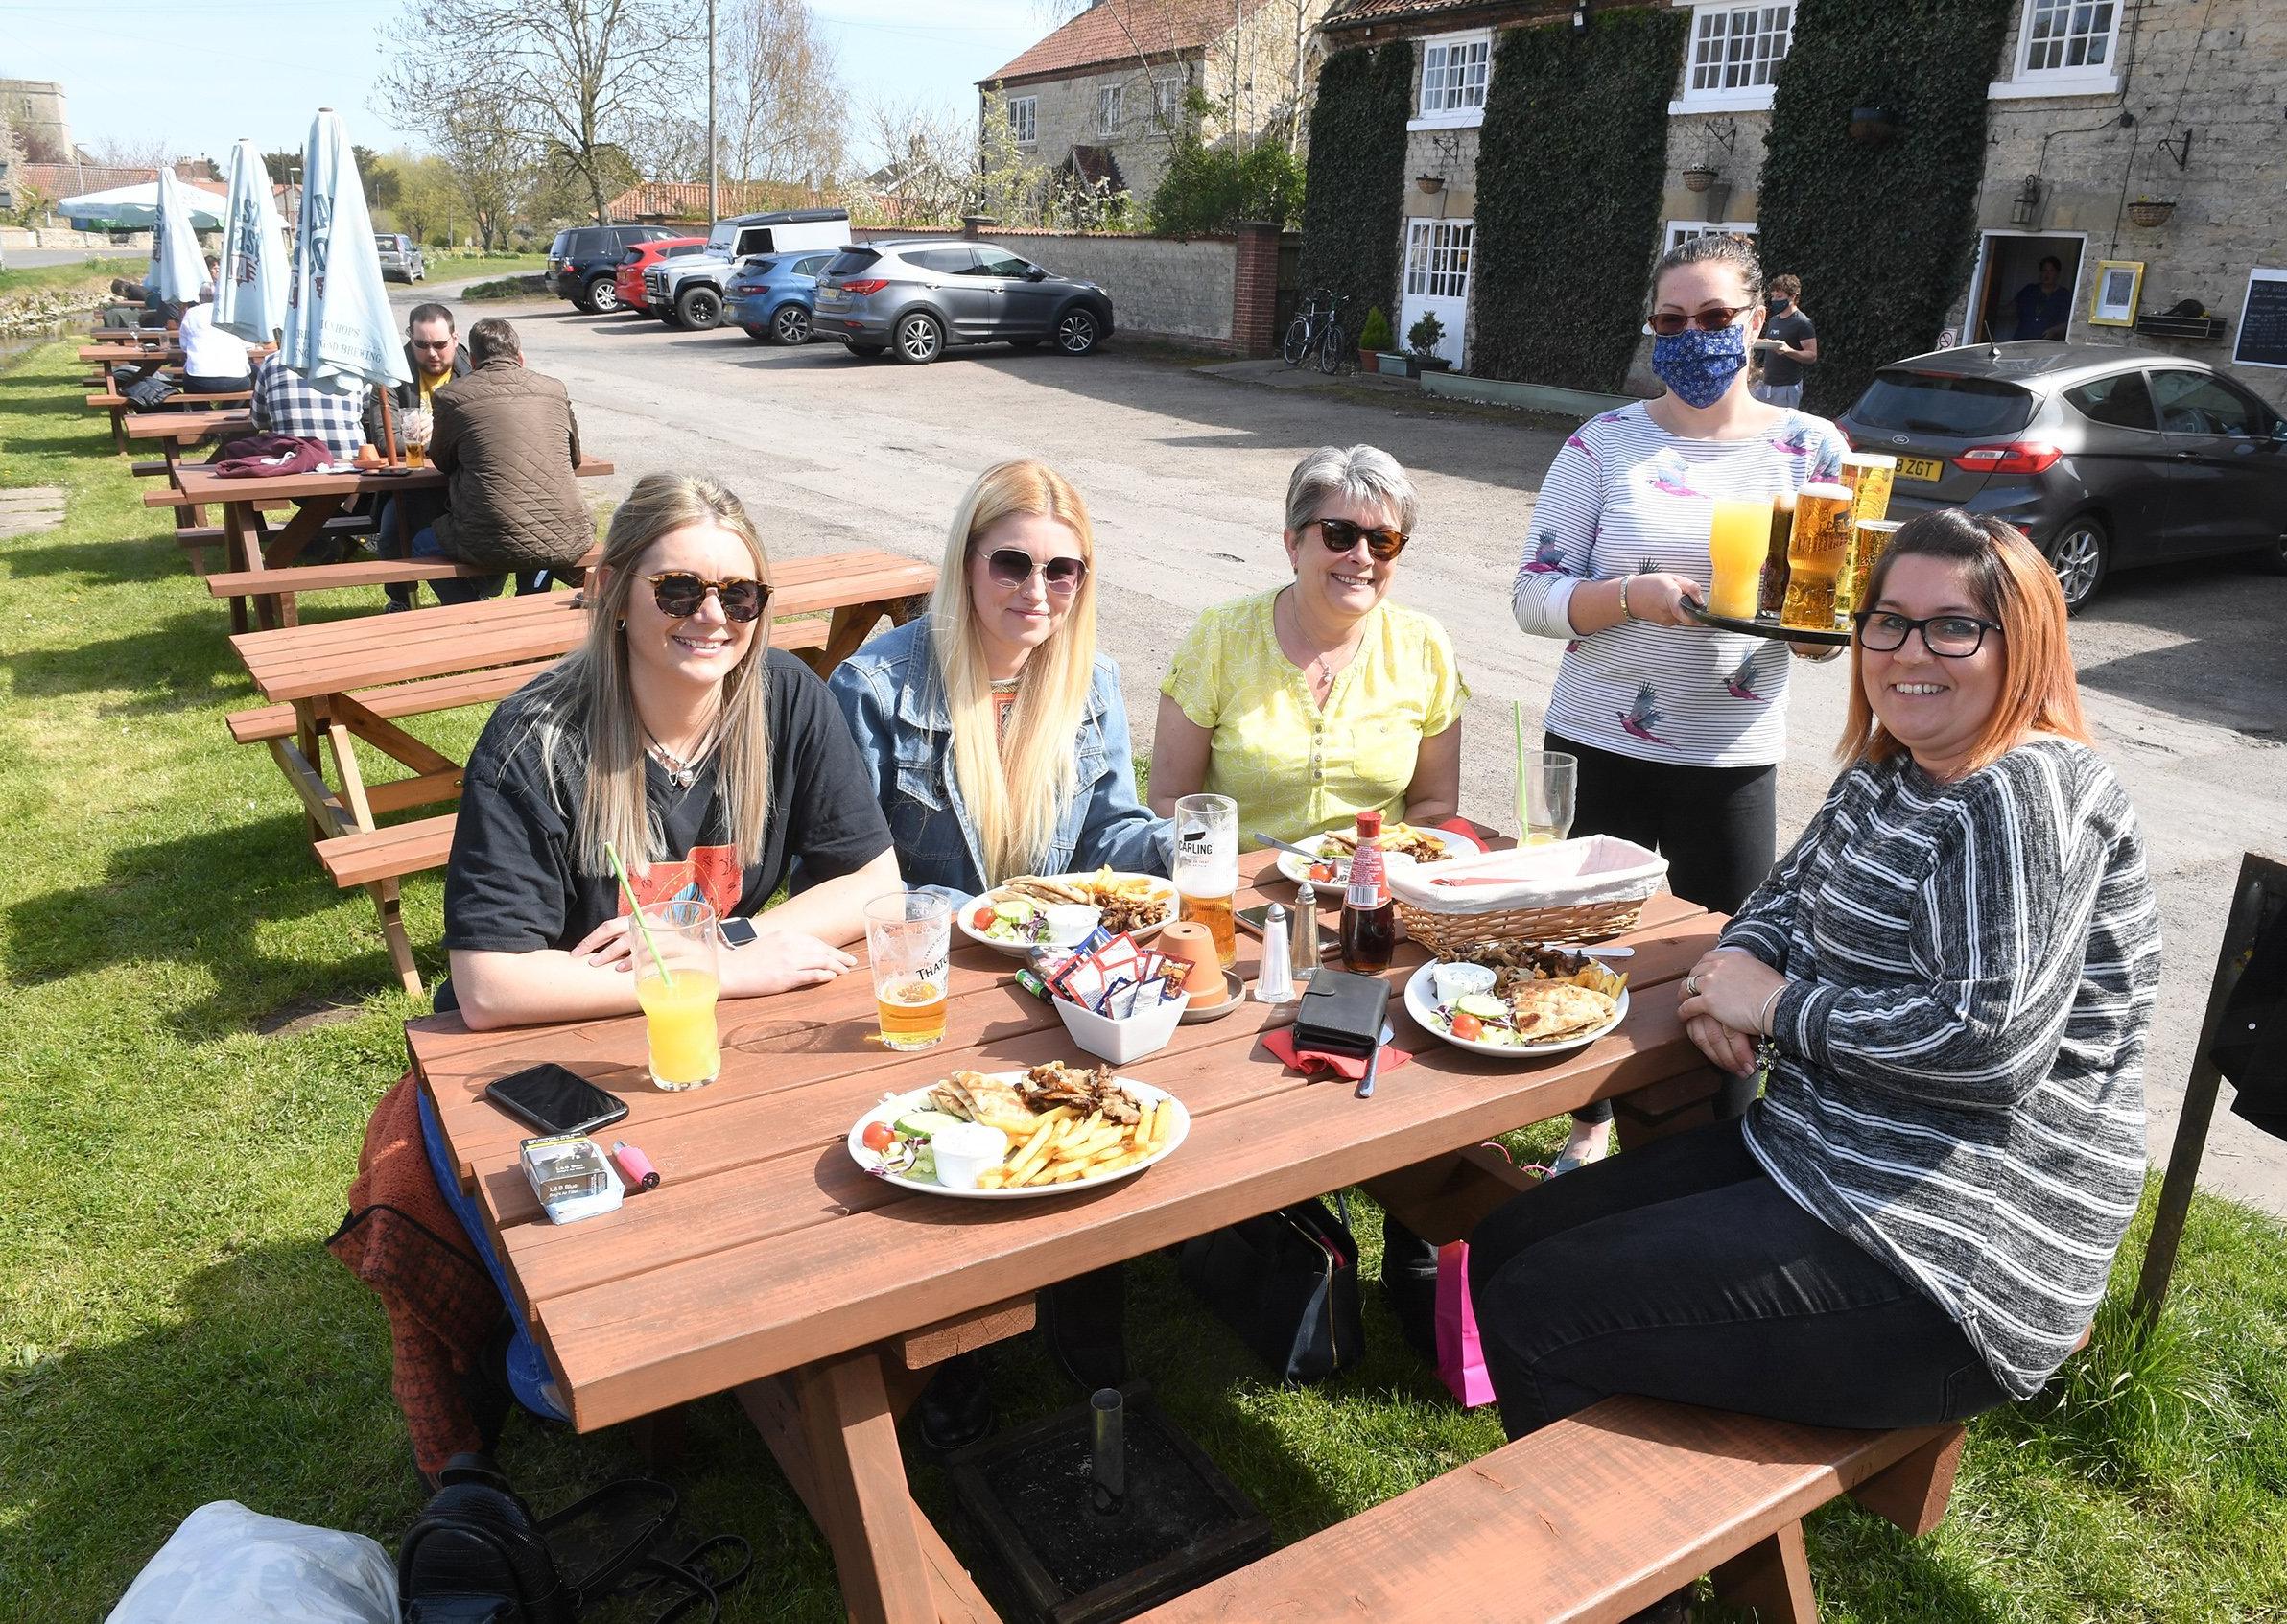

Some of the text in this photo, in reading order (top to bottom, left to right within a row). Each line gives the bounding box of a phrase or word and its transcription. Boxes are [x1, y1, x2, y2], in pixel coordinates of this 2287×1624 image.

[340, 343, 382, 364] BREWING
[1905, 459, 1934, 477] ZGT
[1178, 840, 1212, 855] CARLING
